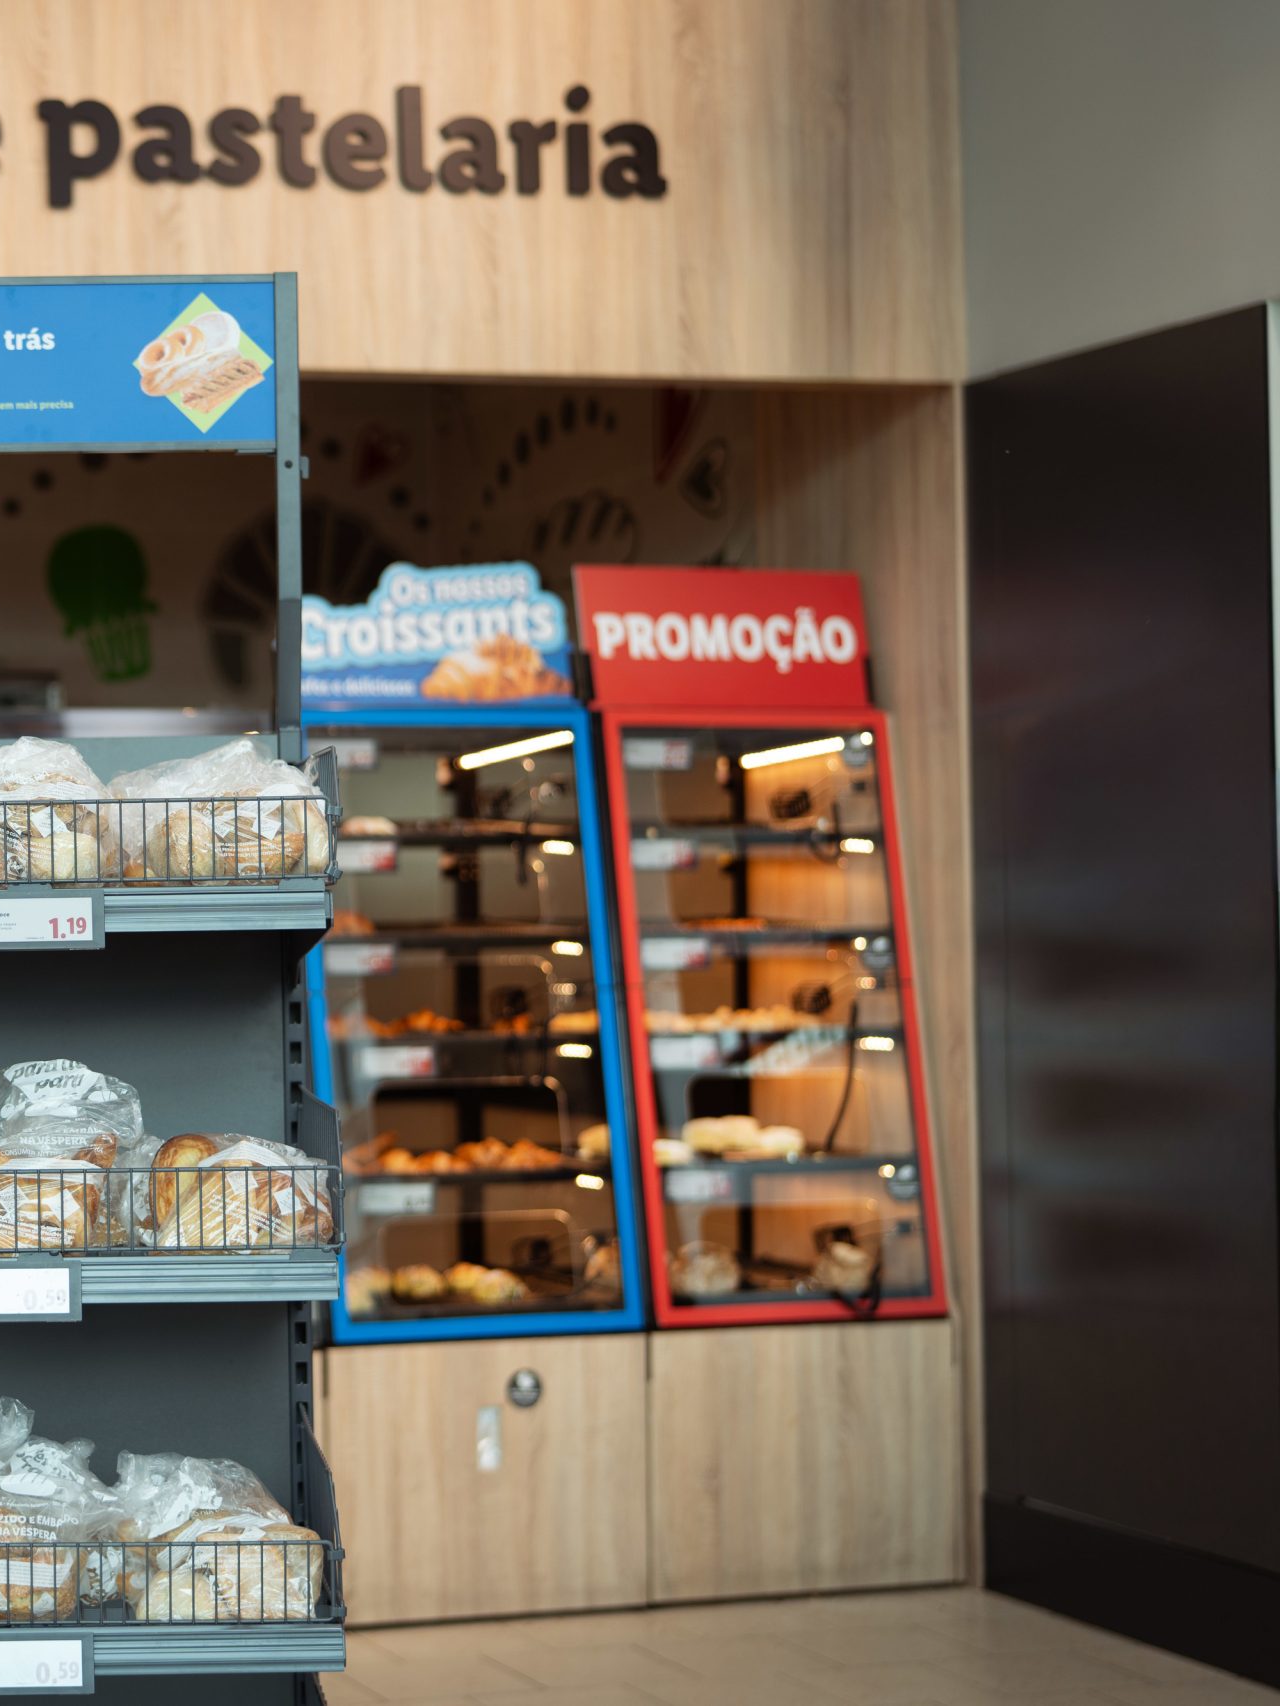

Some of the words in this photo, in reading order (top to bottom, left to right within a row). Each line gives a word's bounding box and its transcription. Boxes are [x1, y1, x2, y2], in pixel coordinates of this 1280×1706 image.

[38, 84, 668, 208] pastelaria
[4, 328, 56, 351] trás
[15, 400, 37, 410] mais
[39, 400, 74, 411] precisa
[390, 574, 427, 603] Os
[434, 573, 526, 601] nossos
[301, 598, 556, 658] Croissants
[593, 605, 858, 675] PROMOÇÃO
[48, 917, 87, 939] 1.19
[12, 1526, 57, 1541] VÉSPERA
